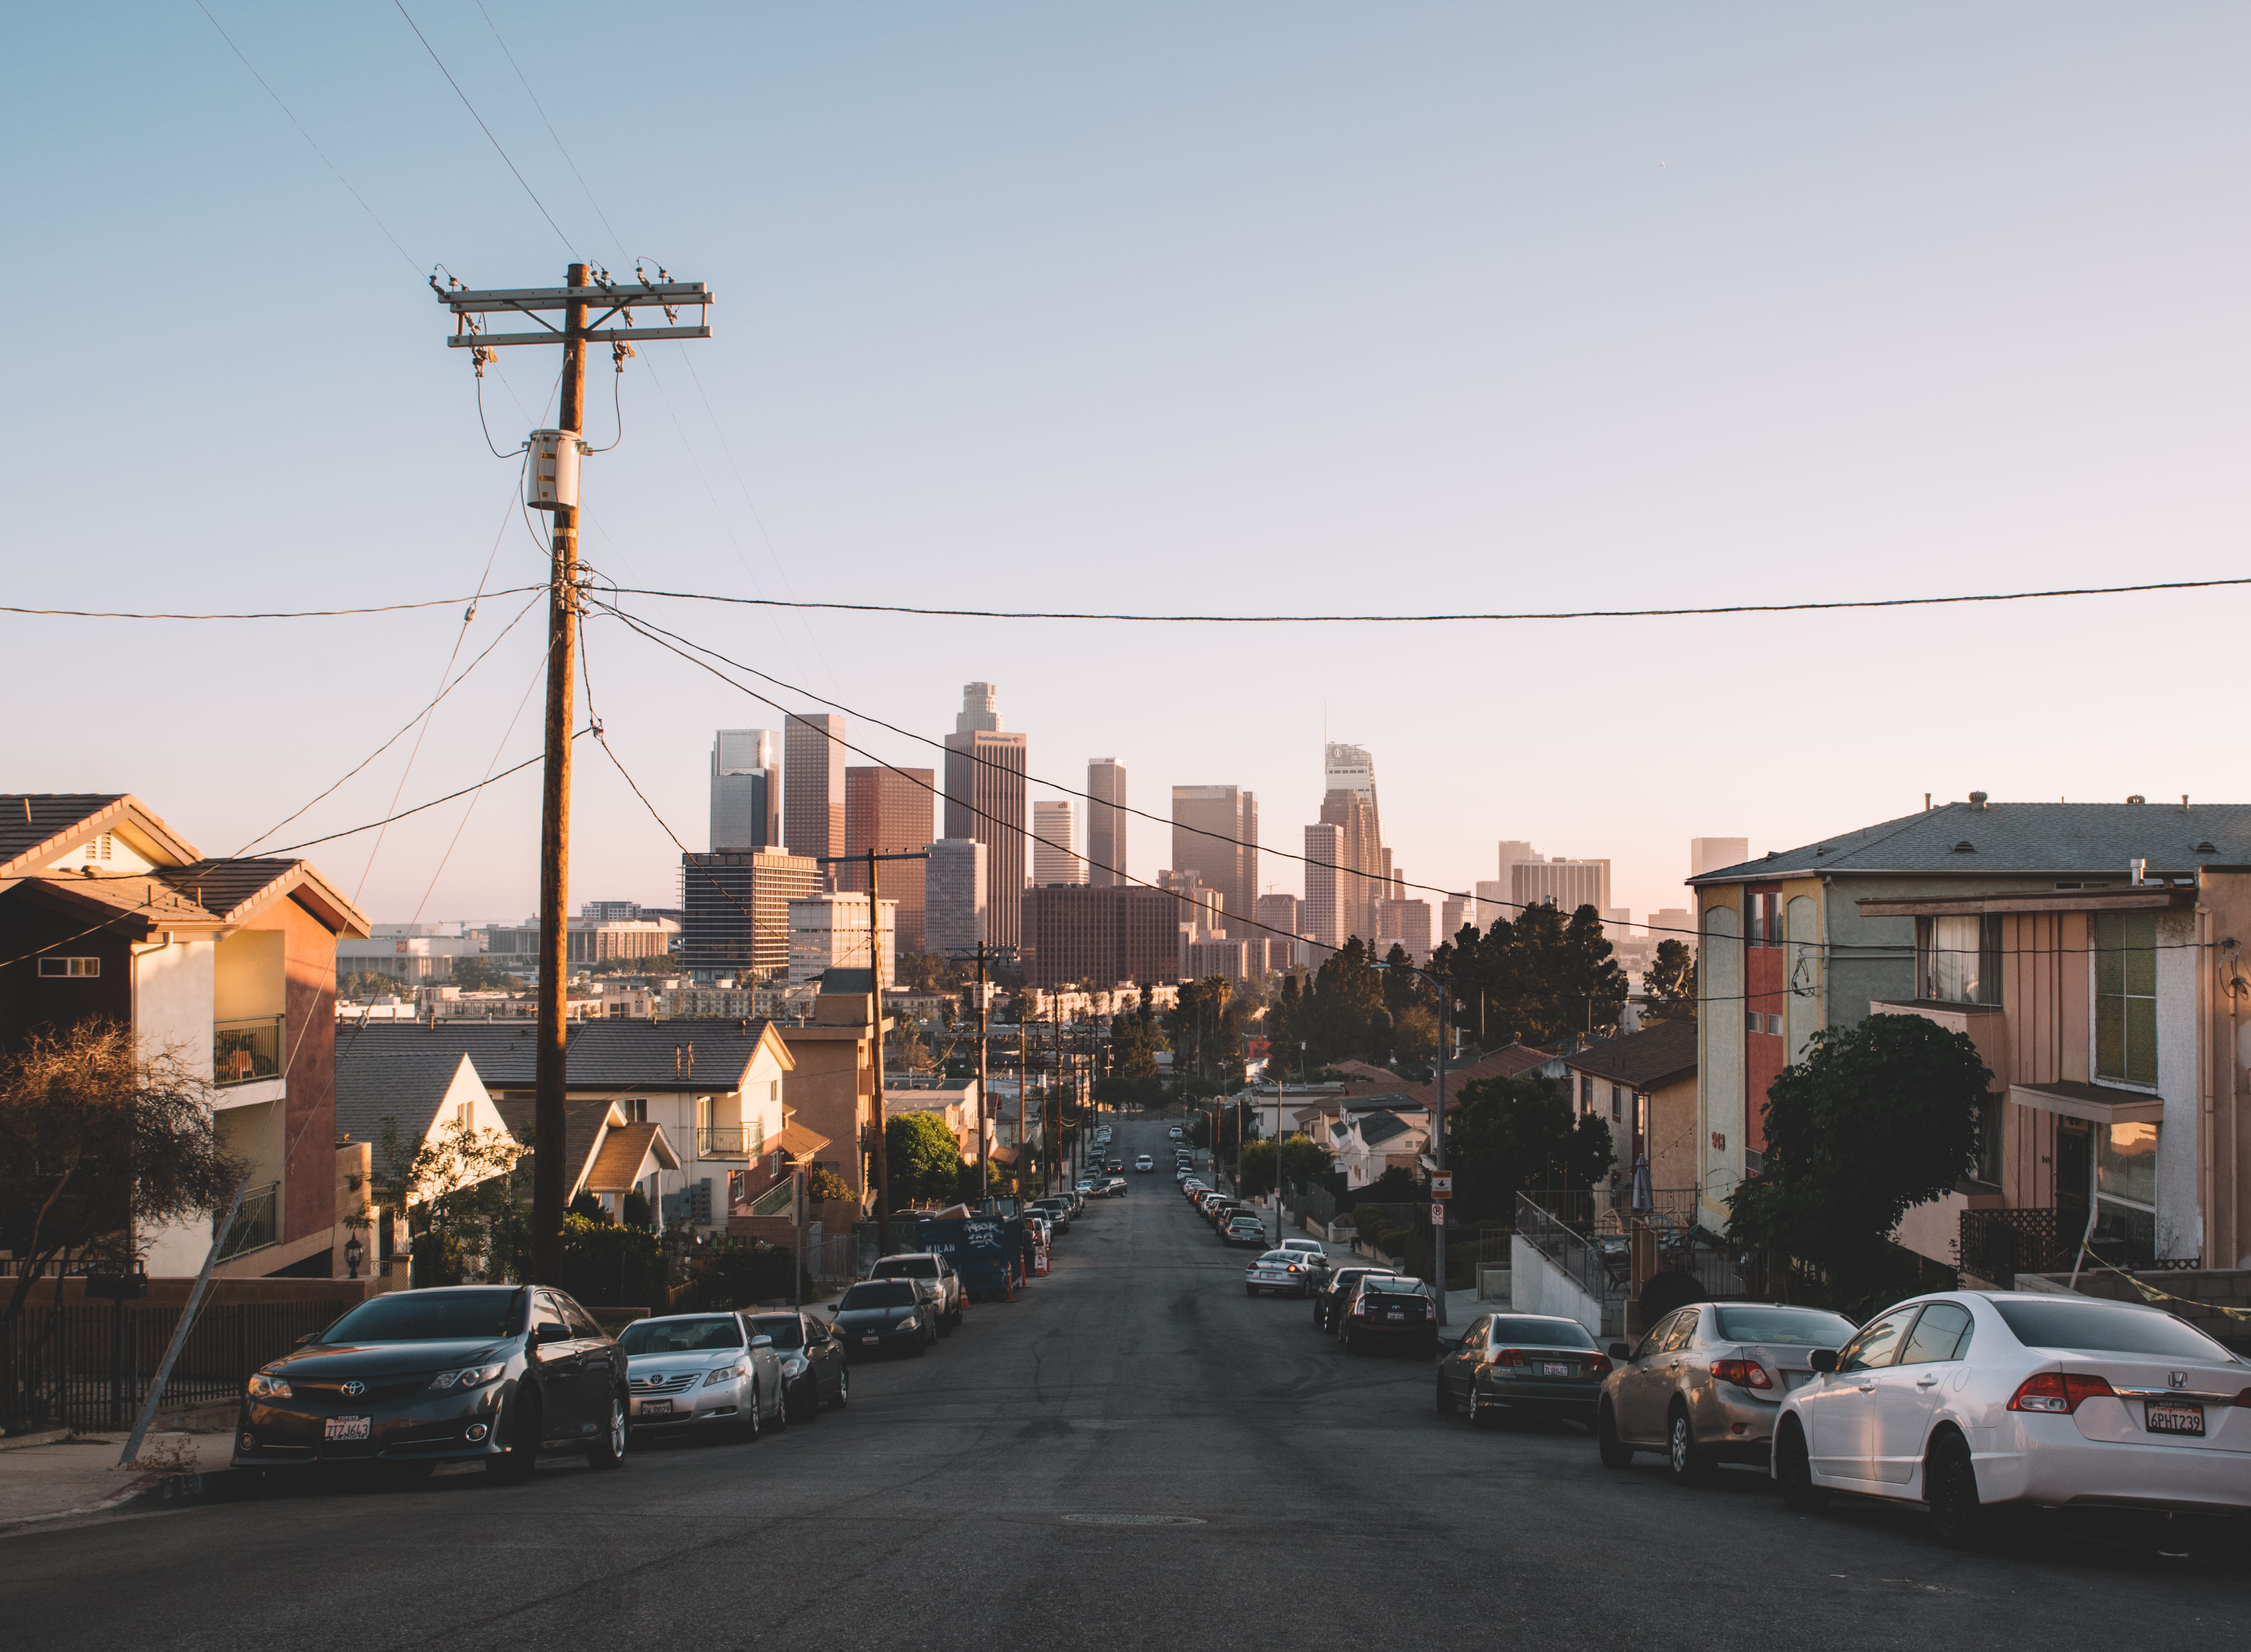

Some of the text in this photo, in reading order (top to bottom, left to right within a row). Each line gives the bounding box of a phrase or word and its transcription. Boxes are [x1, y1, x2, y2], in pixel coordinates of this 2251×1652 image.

[1712, 1131, 1726, 1151] 943
[926, 1244, 955, 1253] MILAN
[2151, 1413, 2200, 1430] 6PHT239
[327, 1424, 368, 1437] 7TZJ643
